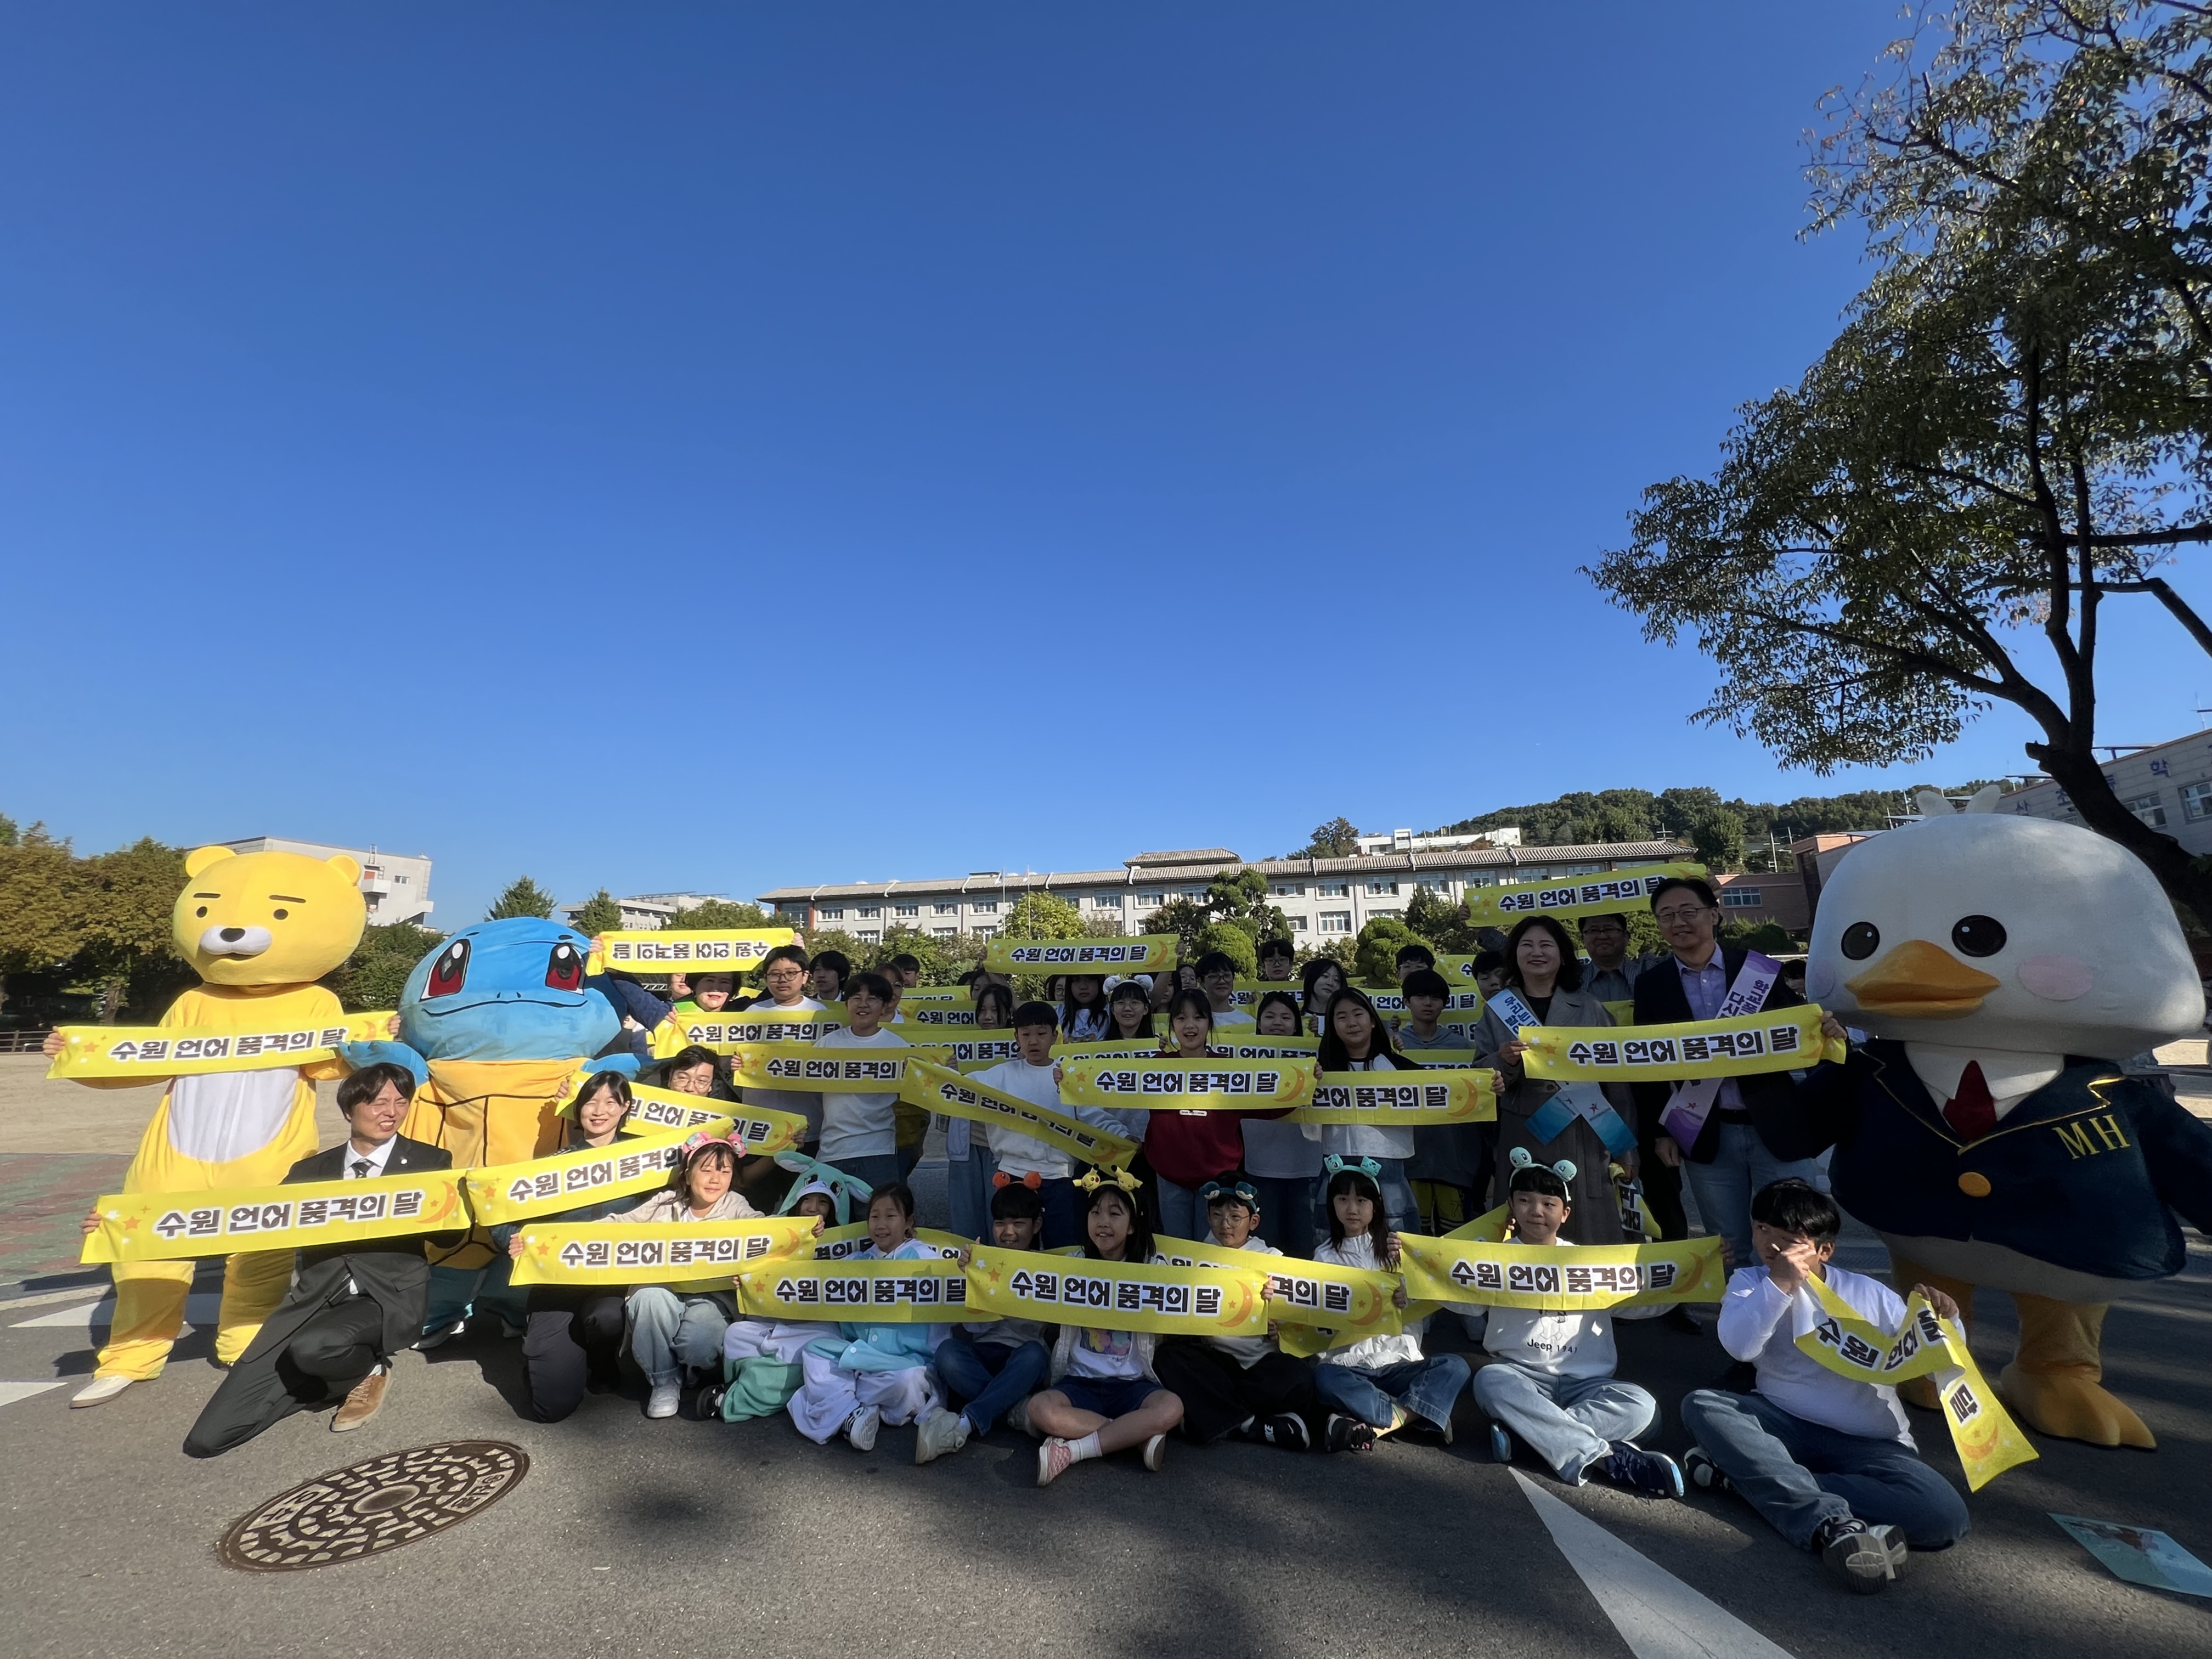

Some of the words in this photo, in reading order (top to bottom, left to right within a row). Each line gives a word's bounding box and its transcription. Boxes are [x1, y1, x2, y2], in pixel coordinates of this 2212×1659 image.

[1500, 895, 1534, 911] 수원
[1540, 889, 1576, 906] 언어
[1581, 881, 1640, 902] 품격의
[613, 943, 631, 959] 달
[637, 943, 691, 959] 품격의
[696, 943, 730, 958] 언어
[735, 942, 768, 958] 수원
[1012, 947, 1041, 962] 수원
[1045, 947, 1076, 962] 언어
[1080, 946, 1125, 962] 품격의
[1130, 945, 1147, 961] 달
[1460, 994, 1476, 1008] 달
[917, 1011, 943, 1024] 수원
[947, 1011, 974, 1024] 언어
[110, 1040, 168, 1060] 수원
[173, 1038, 230, 1059] 언어
[236, 1032, 314, 1056] 품격의
[321, 1028, 347, 1046] 달
[689, 1026, 723, 1042] 수원
[729, 1025, 761, 1041] 언어
[767, 1024, 816, 1041] 품격의
[1569, 1042, 1619, 1065] 수원
[1625, 1040, 1677, 1063] 언어
[1683, 1032, 1763, 1059] 품격의
[1770, 1027, 1797, 1052] 달
[768, 1059, 800, 1077] 수원
[805, 1060, 839, 1078] 언어
[845, 1061, 896, 1079] 품격의
[1097, 1073, 1136, 1092] 수원
[1142, 1073, 1182, 1092] 언어
[1189, 1073, 1251, 1093] 품격의
[1257, 1073, 1279, 1093] 달
[940, 1083, 976, 1104] 수원
[981, 1096, 1015, 1114] 언어
[1312, 1088, 1350, 1107] 언어
[1356, 1087, 1419, 1107] 품격의
[1425, 1086, 1448, 1107] 달
[644, 1102, 685, 1126] 언어
[748, 1122, 770, 1141] 달
[2052, 1114, 2131, 1159] MH
[511, 1173, 558, 1201] 수원
[566, 1161, 612, 1192] 언어
[155, 1208, 221, 1237] 수원
[229, 1203, 292, 1231] 언어
[298, 1195, 386, 1225] 품격의
[393, 1191, 422, 1216] 달
[562, 1242, 609, 1266] 수원
[616, 1241, 663, 1265] 언어
[670, 1239, 740, 1263] 품격의
[746, 1237, 770, 1259] 달
[776, 1279, 819, 1302] 수원
[825, 1279, 867, 1303] 언어
[874, 1279, 939, 1302] 품격의
[1452, 1261, 1502, 1289] 수원
[1508, 1265, 1560, 1293] 언어
[1566, 1265, 1643, 1292] 품격의
[1650, 1263, 1675, 1289] 달
[1012, 1271, 1057, 1300] 수원
[1064, 1277, 1110, 1307] 언어
[1118, 1283, 1189, 1313] 품격의
[1196, 1286, 1221, 1314] 달
[1325, 1284, 1350, 1312] 달
[1527, 1339, 1553, 1351] Jeep
[1556, 1345, 1578, 1353] 1941
[1816, 1317, 1879, 1368] 수원
[1949, 1384, 1978, 1424] 달
[262, 1490, 320, 1522] 오수
